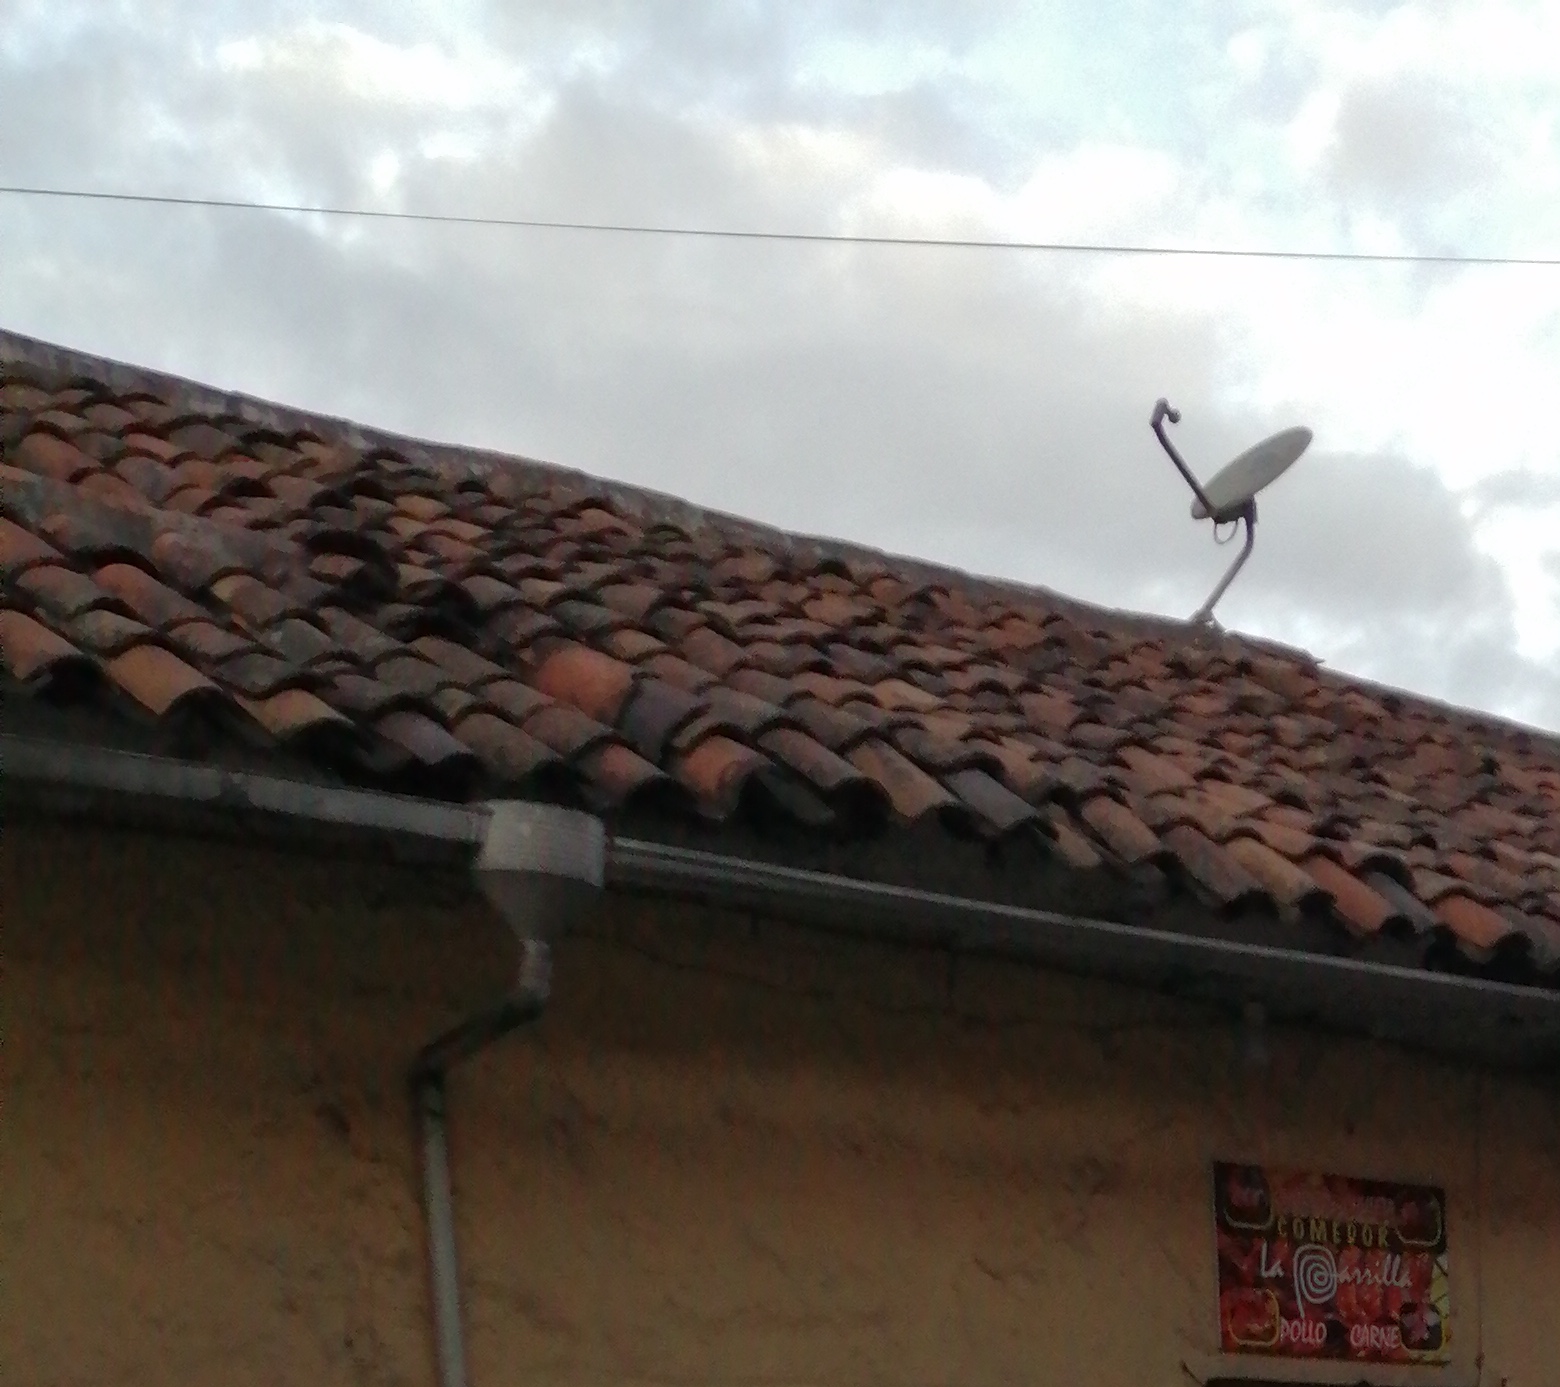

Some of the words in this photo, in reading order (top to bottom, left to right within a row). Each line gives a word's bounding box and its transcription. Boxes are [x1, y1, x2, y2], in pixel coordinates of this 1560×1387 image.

[1277, 1216, 1390, 1249] COMEDOR
[1279, 1317, 1328, 1345] POLLO
[1350, 1323, 1401, 1350] CARNE
